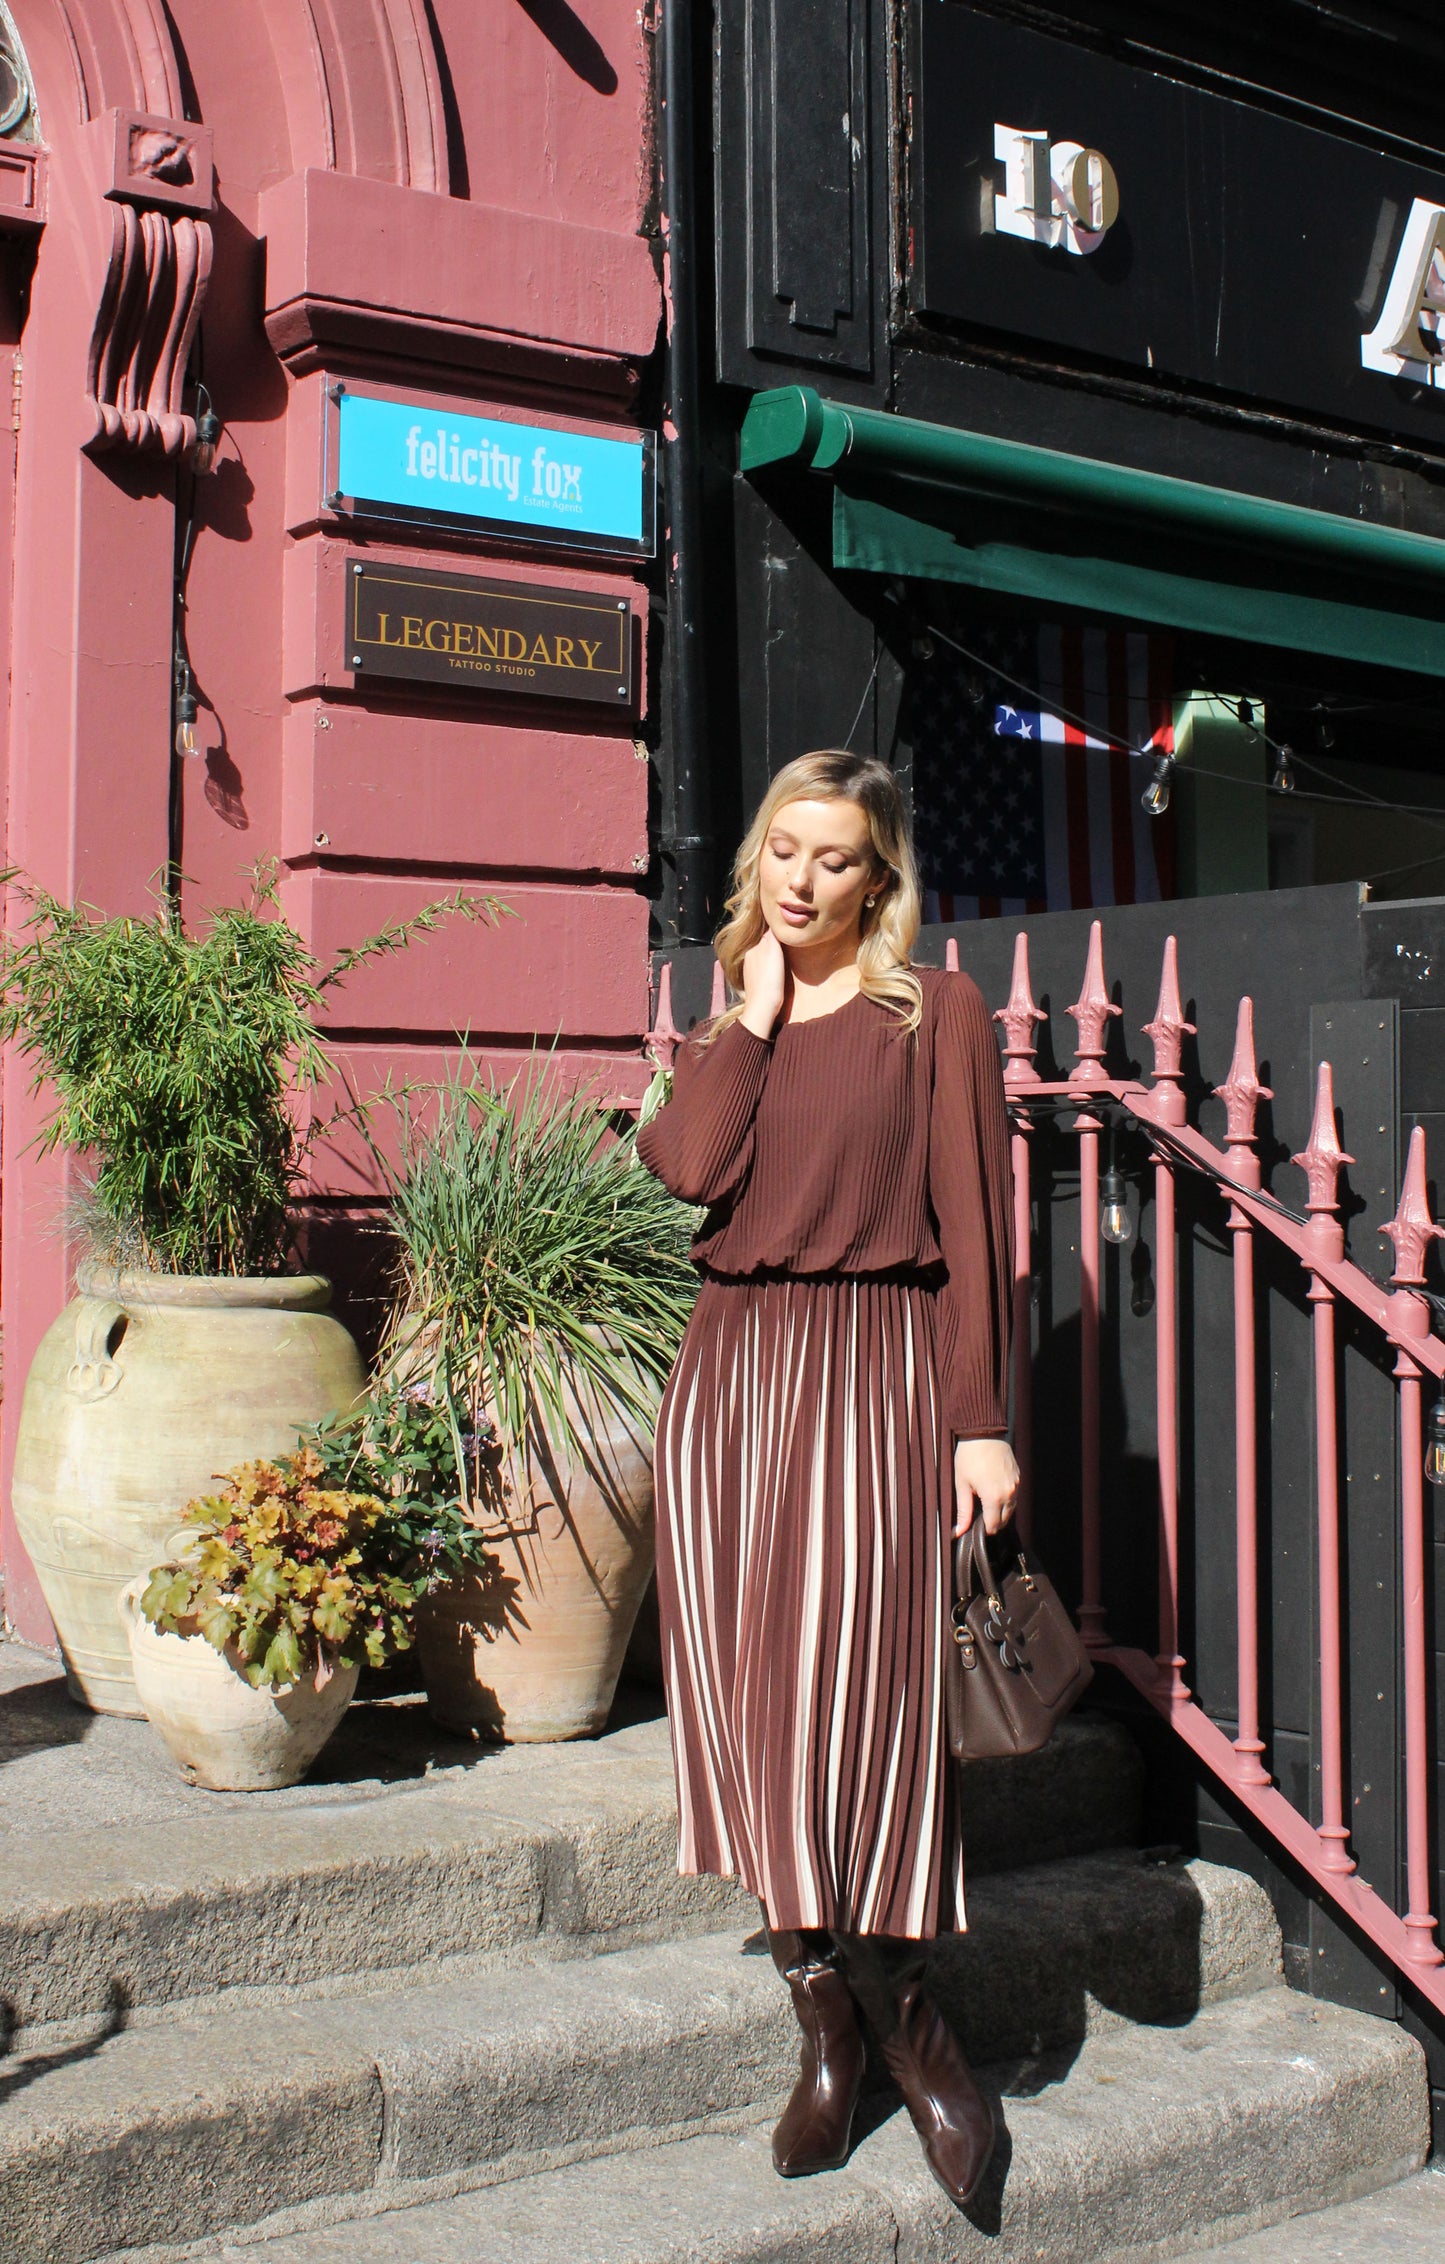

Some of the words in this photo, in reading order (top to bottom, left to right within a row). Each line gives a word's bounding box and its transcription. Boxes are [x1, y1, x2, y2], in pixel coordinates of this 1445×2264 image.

[994, 123, 1119, 255] 10
[406, 425, 522, 502] felicity
[532, 446, 583, 502] fox
[523, 495, 551, 509] Estate
[552, 500, 584, 514] Agents
[377, 613, 603, 671] LEGENDARY
[448, 658, 492, 672] TATTOO
[495, 664, 536, 677] STUDIO
